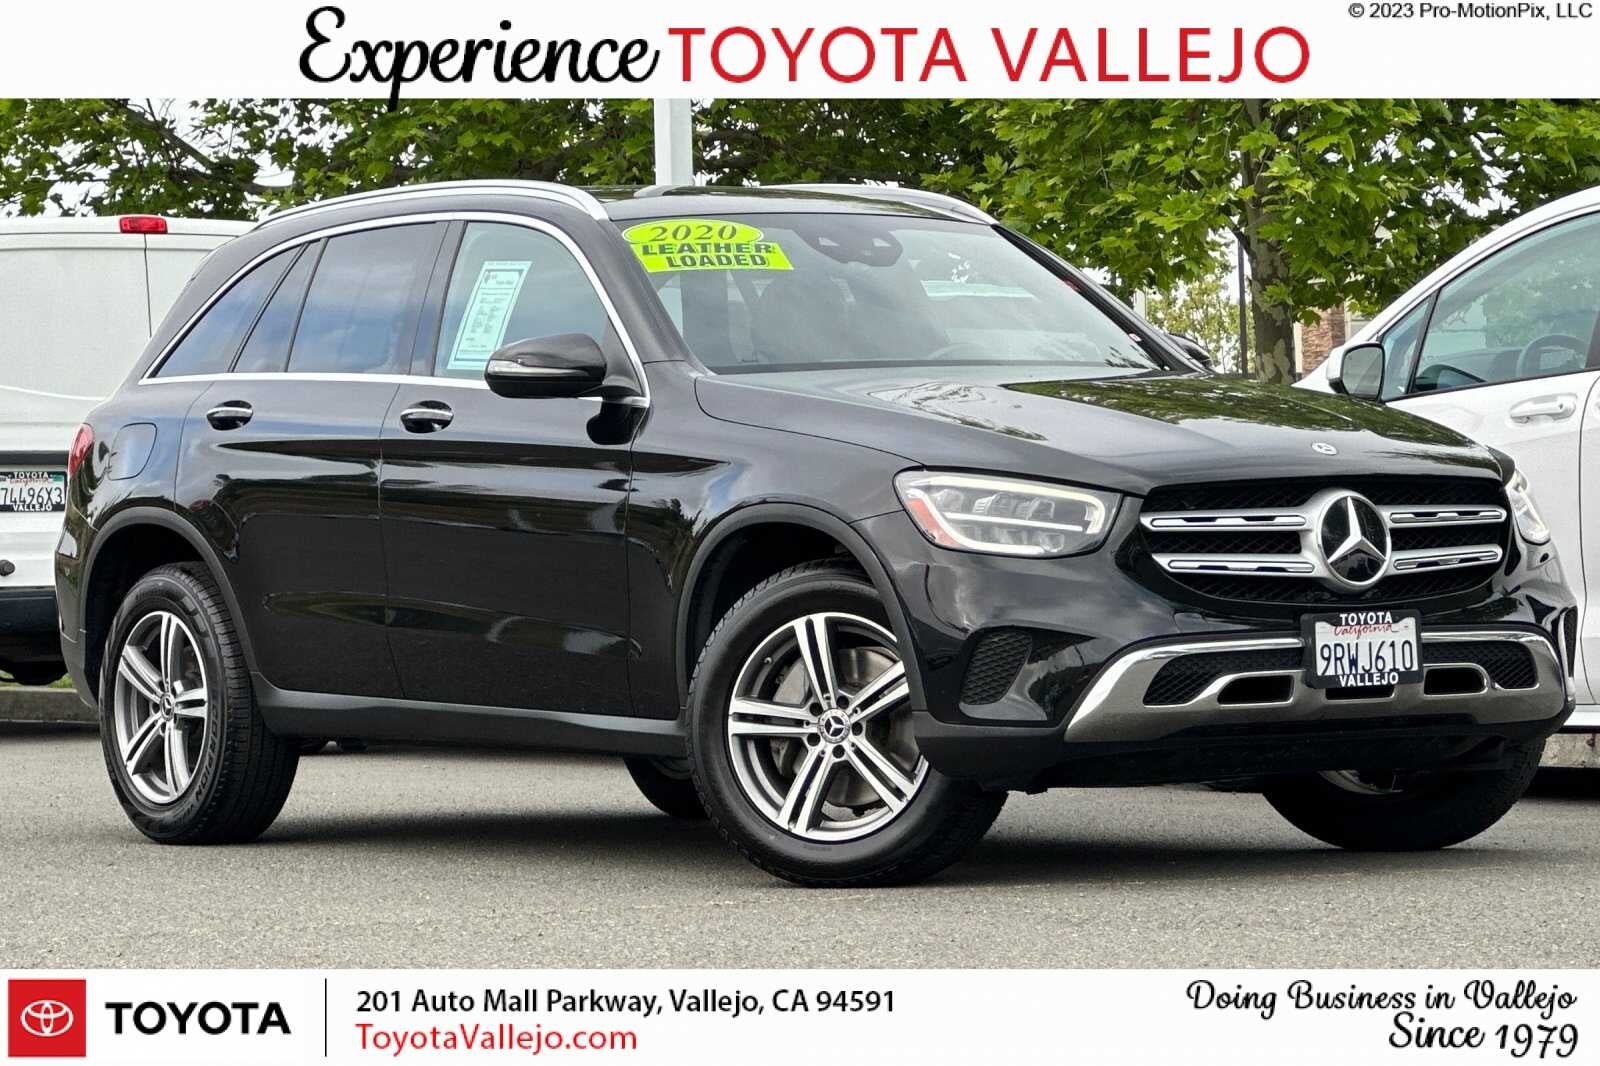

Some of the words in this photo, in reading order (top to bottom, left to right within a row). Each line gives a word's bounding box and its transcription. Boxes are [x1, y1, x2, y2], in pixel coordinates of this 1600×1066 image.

[650, 225, 737, 242] 2020
[642, 242, 773, 256] LEATHER
[666, 254, 769, 268] LOADED
[13, 471, 49, 479] TOYOTA
[0, 487, 63, 505] 74496X3
[1339, 611, 1393, 626] TOYOTA
[1320, 640, 1414, 675] 9RWJ610
[1339, 671, 1399, 687] VALLEJO
